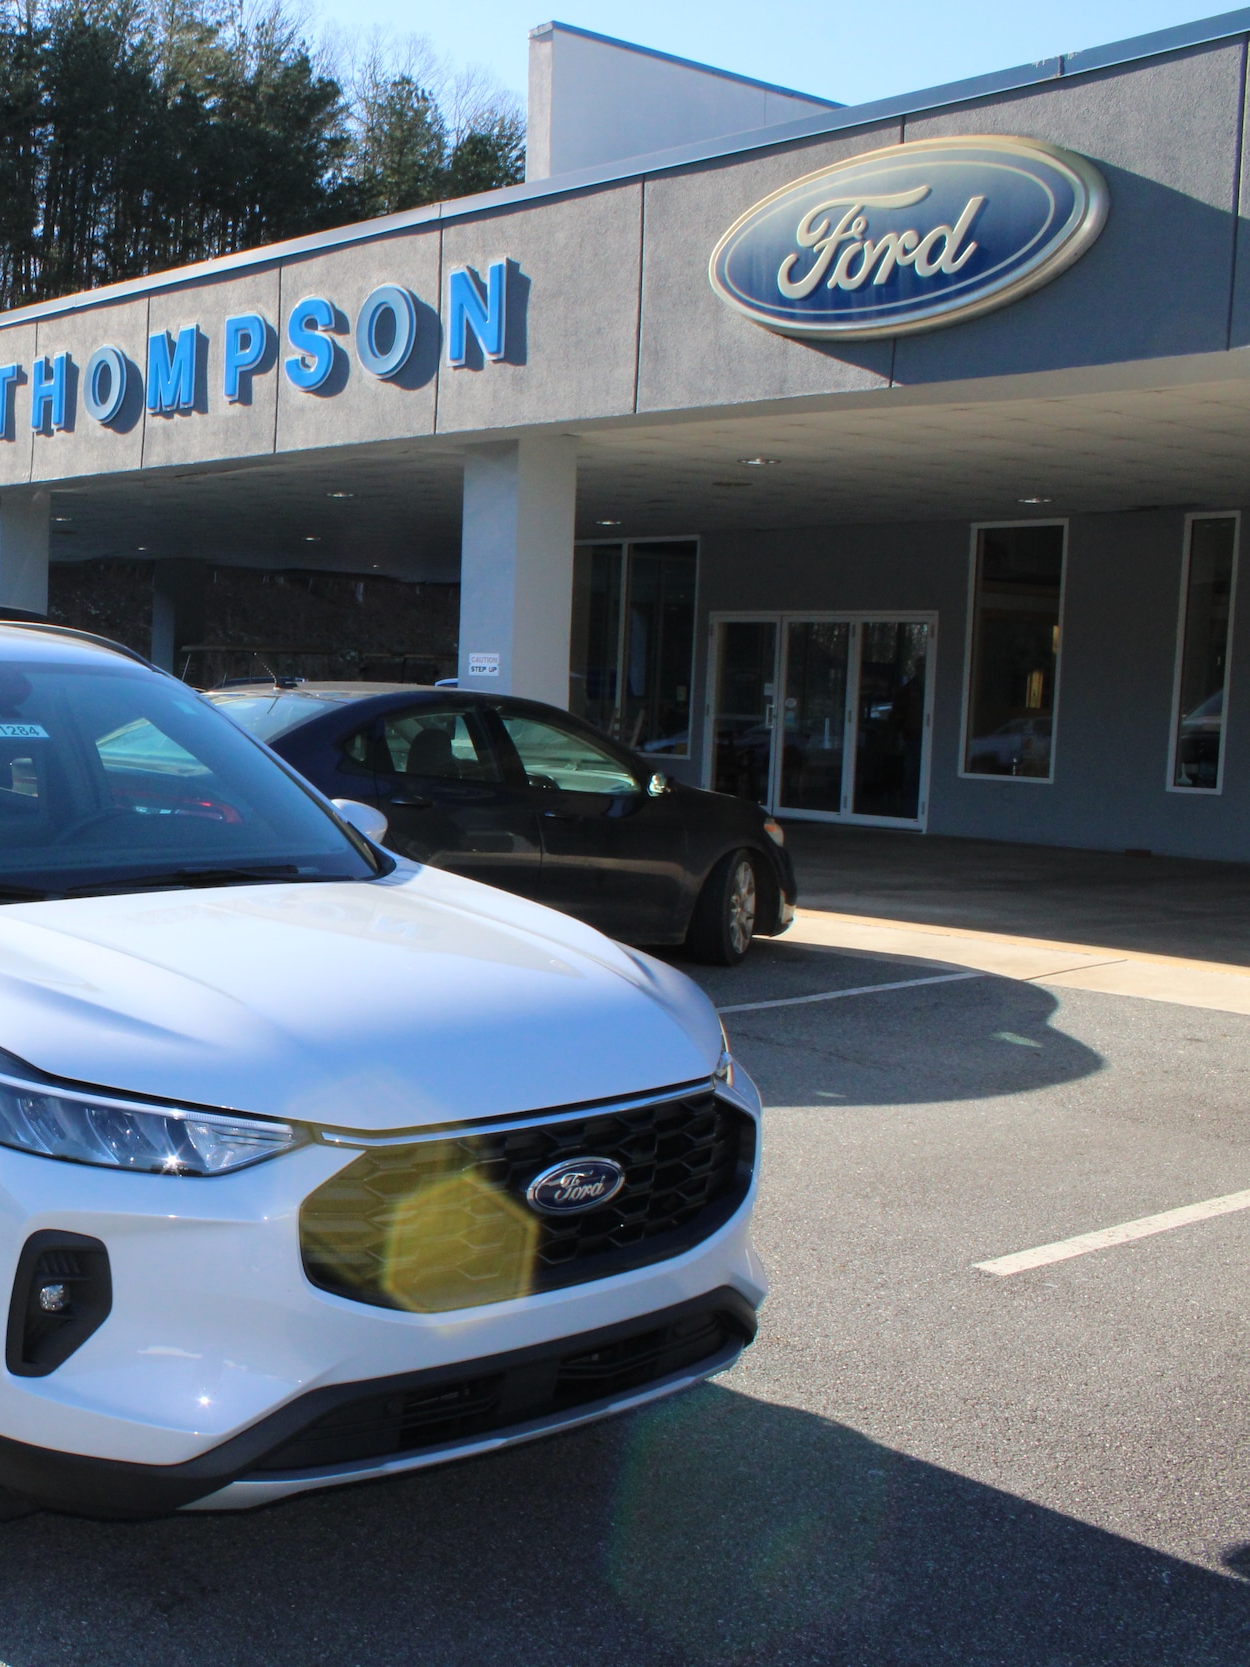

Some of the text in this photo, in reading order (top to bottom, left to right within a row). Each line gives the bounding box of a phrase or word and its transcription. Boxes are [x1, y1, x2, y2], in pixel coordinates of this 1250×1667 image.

[776, 184, 986, 300] Ford
[470, 655, 499, 664] CAUTION
[470, 665, 498, 673] STEP UP
[553, 1169, 606, 1201] Ford
